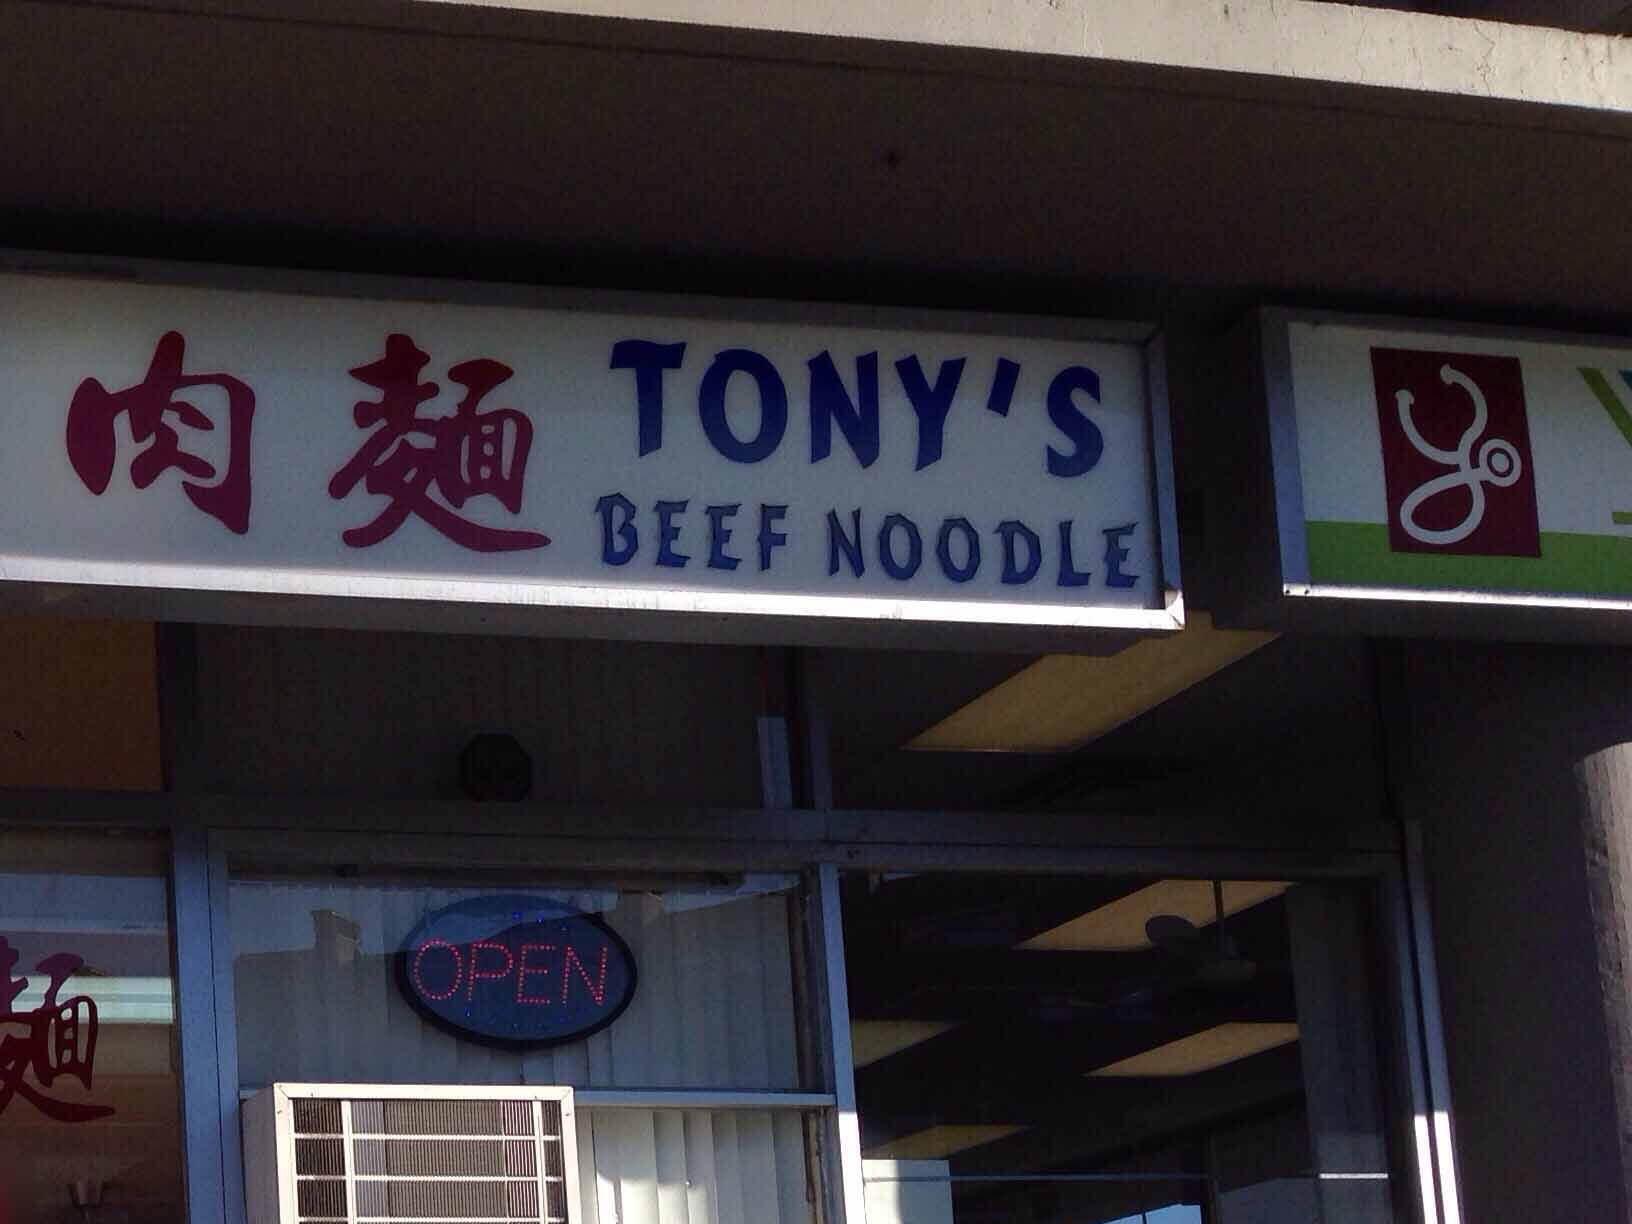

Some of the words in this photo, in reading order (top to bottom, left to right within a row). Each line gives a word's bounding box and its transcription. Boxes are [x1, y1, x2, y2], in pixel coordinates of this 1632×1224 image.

[609, 339, 1105, 478] TONY'S
[595, 492, 788, 571] BEEF
[826, 508, 1140, 588] NOODLE
[412, 939, 608, 1006] OPEN
